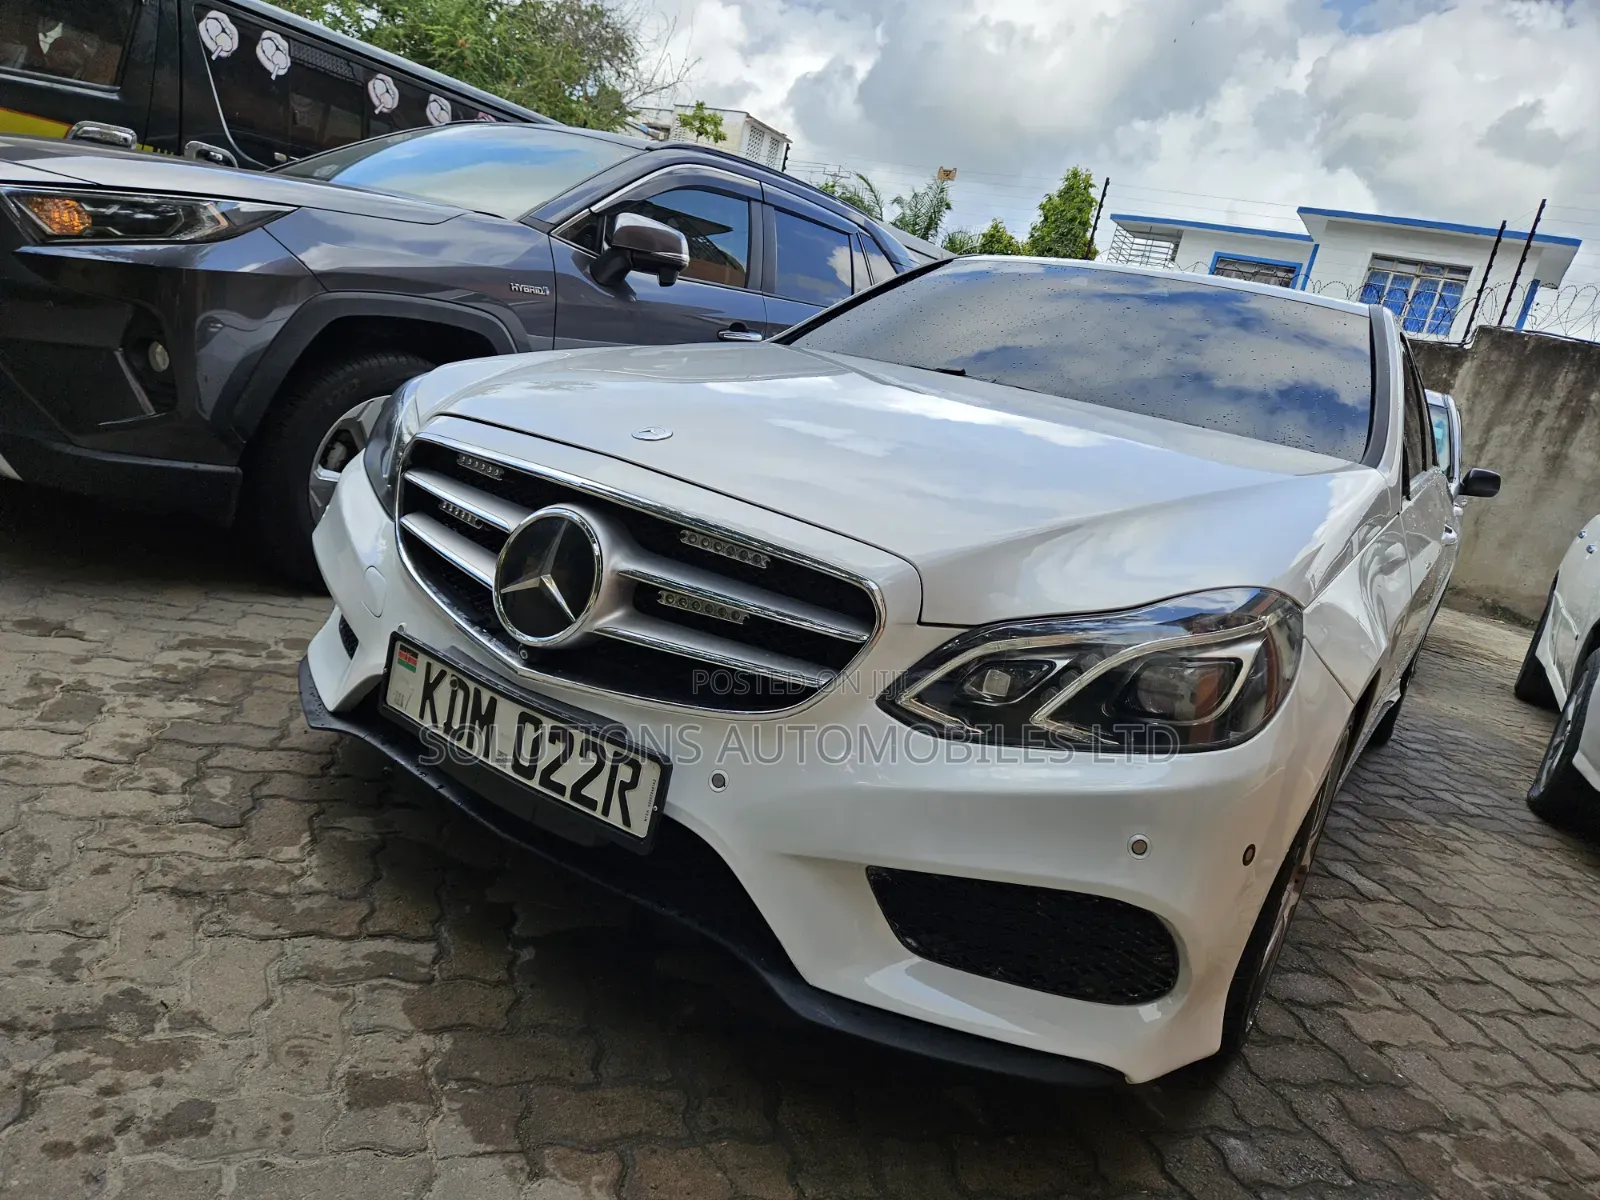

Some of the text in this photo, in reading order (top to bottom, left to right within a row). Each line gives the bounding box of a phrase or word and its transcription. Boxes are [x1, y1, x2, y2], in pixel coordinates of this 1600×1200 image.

[510, 282, 544, 295] HYBRID
[418, 661, 642, 828] KDM 022R
